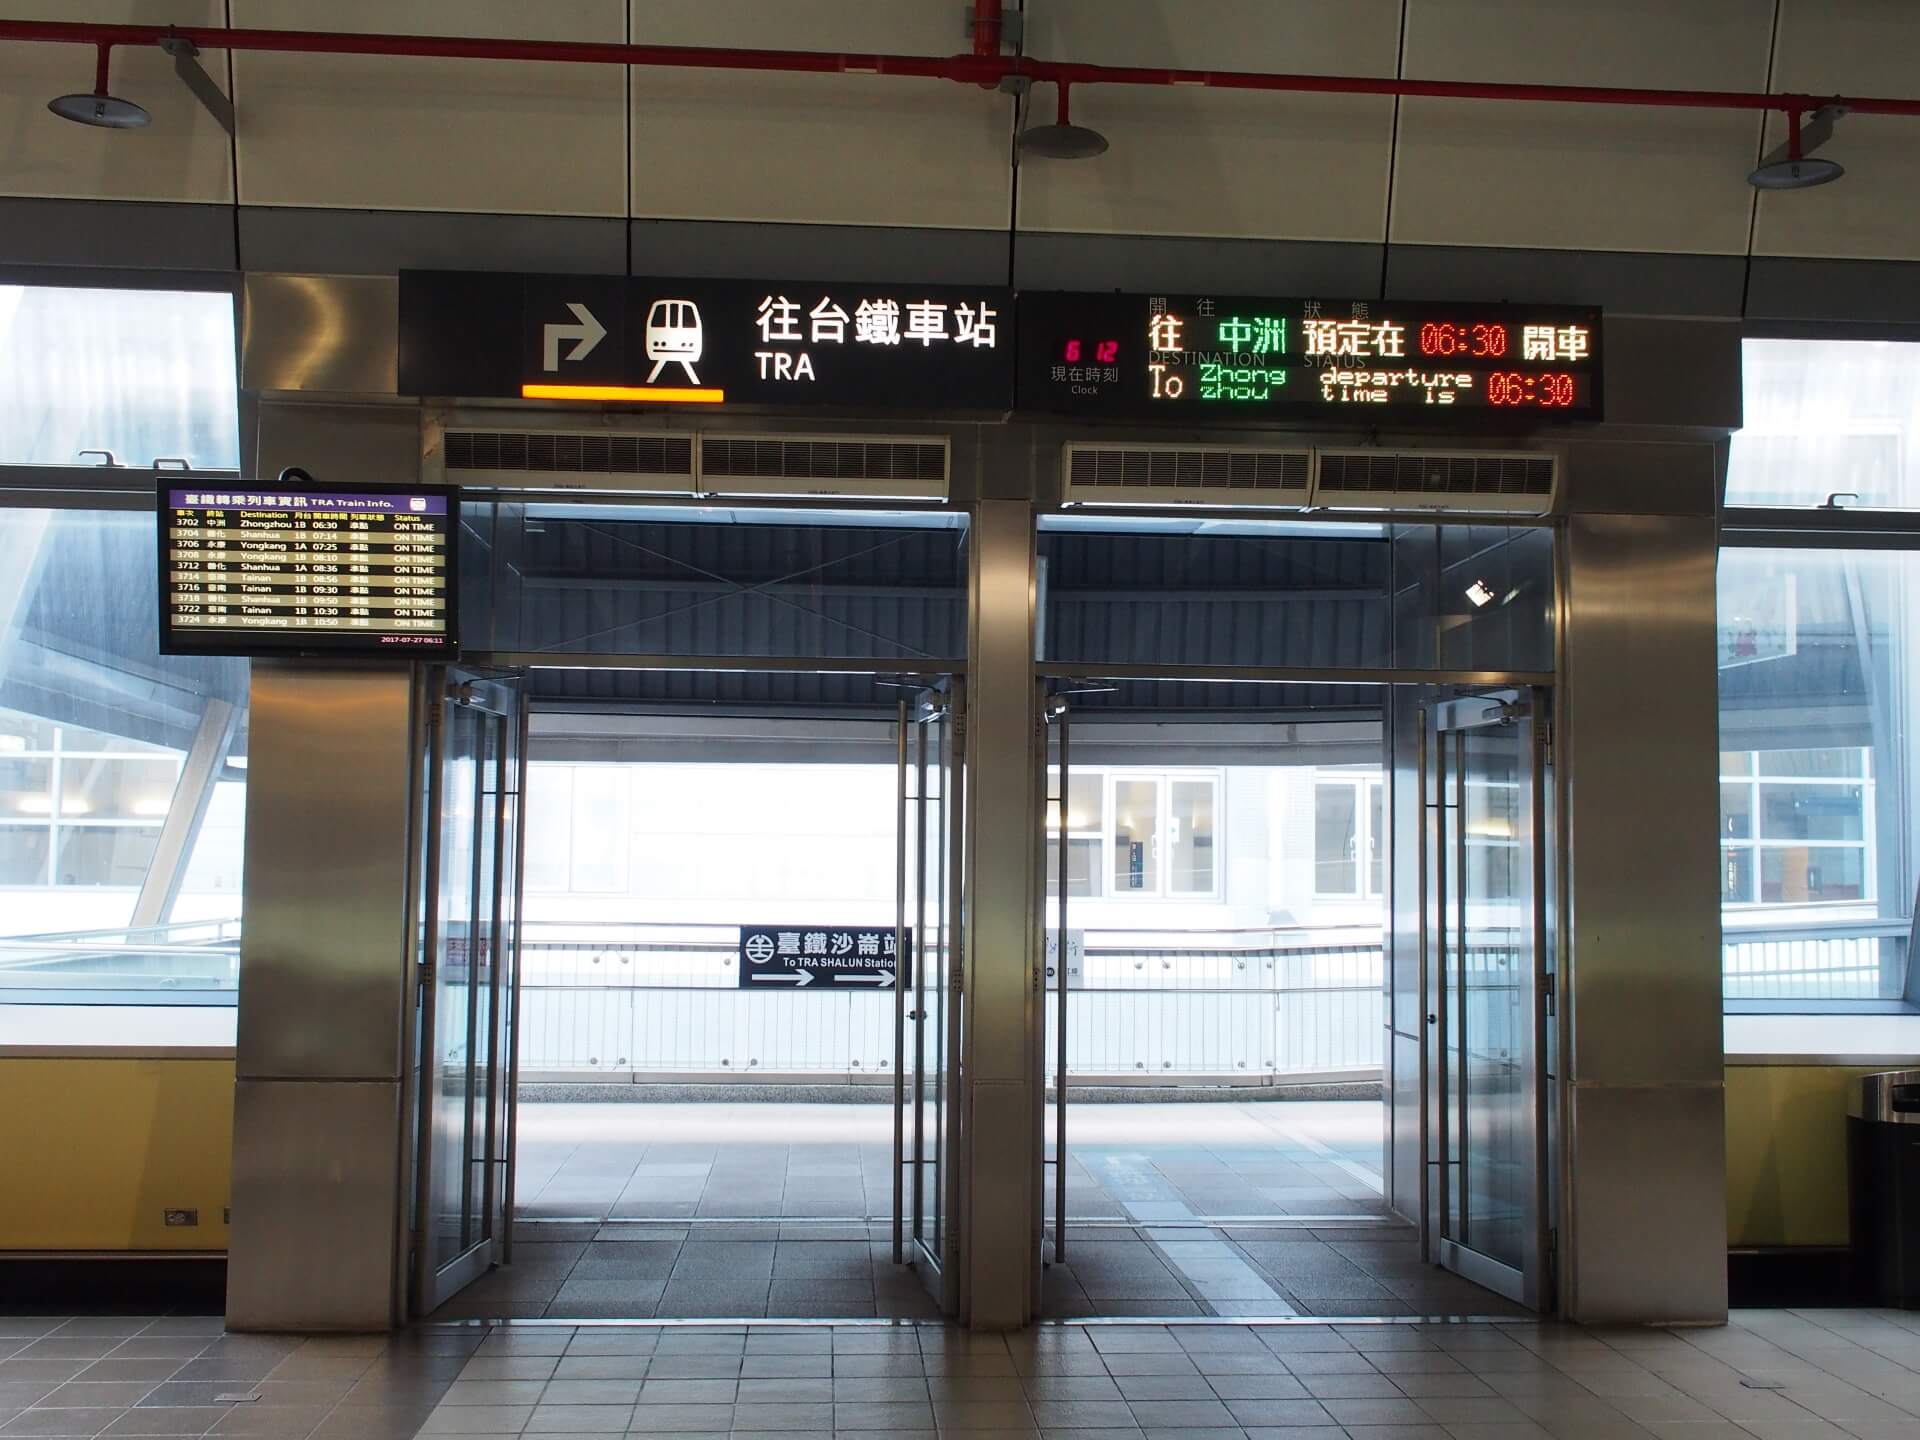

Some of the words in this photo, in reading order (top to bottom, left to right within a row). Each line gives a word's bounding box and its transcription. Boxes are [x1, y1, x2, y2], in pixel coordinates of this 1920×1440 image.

[756, 295, 998, 348] 往台鐵車站
[1149, 314, 1184, 352] 往
[1219, 316, 1286, 354] 中洲
[1302, 319, 1405, 357] 預定在
[1421, 323, 1507, 357] 06:30
[1522, 325, 1589, 361] 開車
[1149, 351, 1265, 367] DESTINATION
[1303, 353, 1366, 369] STATUS
[755, 351, 816, 381] TRA
[1050, 366, 1120, 383] 現在時刻
[1149, 364, 1183, 398] To
[1200, 364, 1287, 385] Zhong
[1319, 367, 1473, 388] departure
[1071, 385, 1098, 394] Clock
[1200, 383, 1269, 399] zhou
[1321, 384, 1388, 402] time
[1425, 386, 1455, 404] is
[1488, 372, 1574, 406] 06:30
[367, 500, 395, 508] Info.
[240, 511, 288, 519] Destination
[177, 518, 199, 526] 3702
[240, 520, 292, 529] Zhongzhou
[394, 523, 410, 531] ON
[176, 529, 199, 537] 3704
[394, 533, 410, 541] ON
[177, 540, 200, 548] 3706
[240, 542, 287, 551] Yongkang
[312, 543, 338, 551] 07:25
[394, 544, 410, 552] ON
[240, 553, 288, 562] Yongkang
[394, 554, 410, 562] ON
[240, 563, 281, 571] Shanhua
[394, 566, 410, 574] ON
[241, 574, 272, 582] Tainan
[394, 576, 410, 584] ON
[241, 585, 272, 593] Tainan
[313, 586, 338, 594] 09:30
[394, 587, 410, 595] ON
[394, 597, 410, 605] ON
[178, 605, 200, 613] 3722
[241, 606, 272, 614] Tainan
[394, 608, 410, 616] ON
[394, 619, 410, 627] ON
[783, 957, 796, 967] To
[798, 957, 819, 968] TRA
[820, 957, 863, 968] SHALUN
